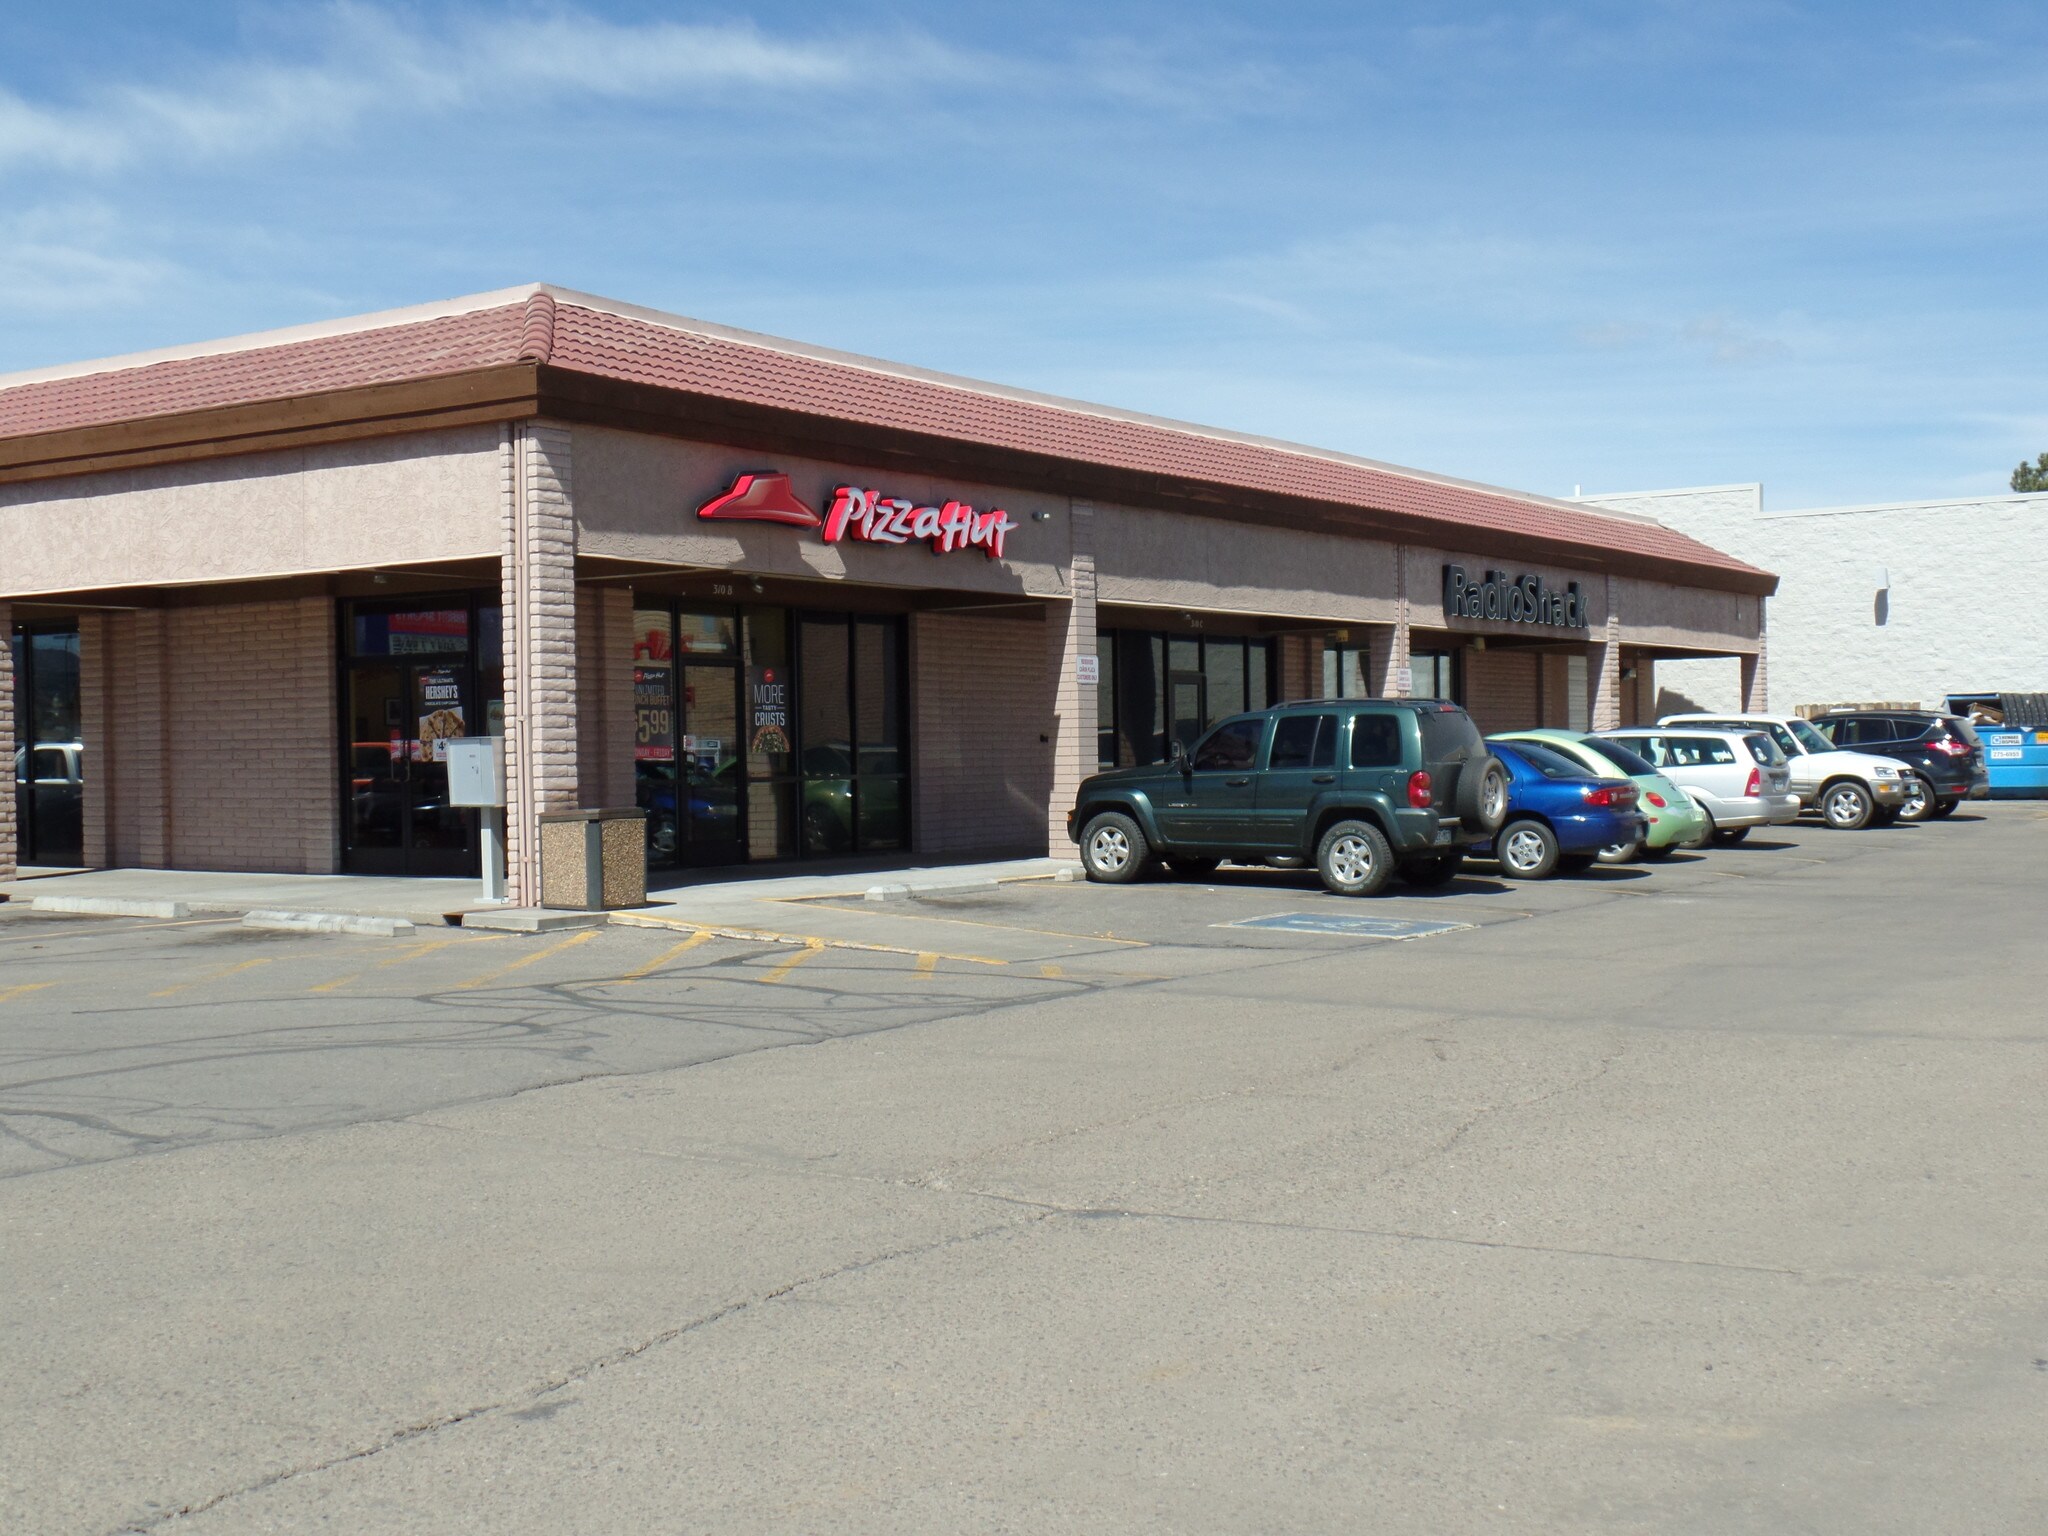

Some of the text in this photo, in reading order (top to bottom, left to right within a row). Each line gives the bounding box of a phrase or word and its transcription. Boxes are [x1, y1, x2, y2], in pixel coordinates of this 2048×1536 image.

[824, 486, 1019, 559] Pizza Hut
[1443, 564, 1590, 628] RadioShack
[426, 685, 459, 699] HERSHEY'S
[754, 685, 784, 703] MORE
[755, 712, 785, 726] CRUSTS
